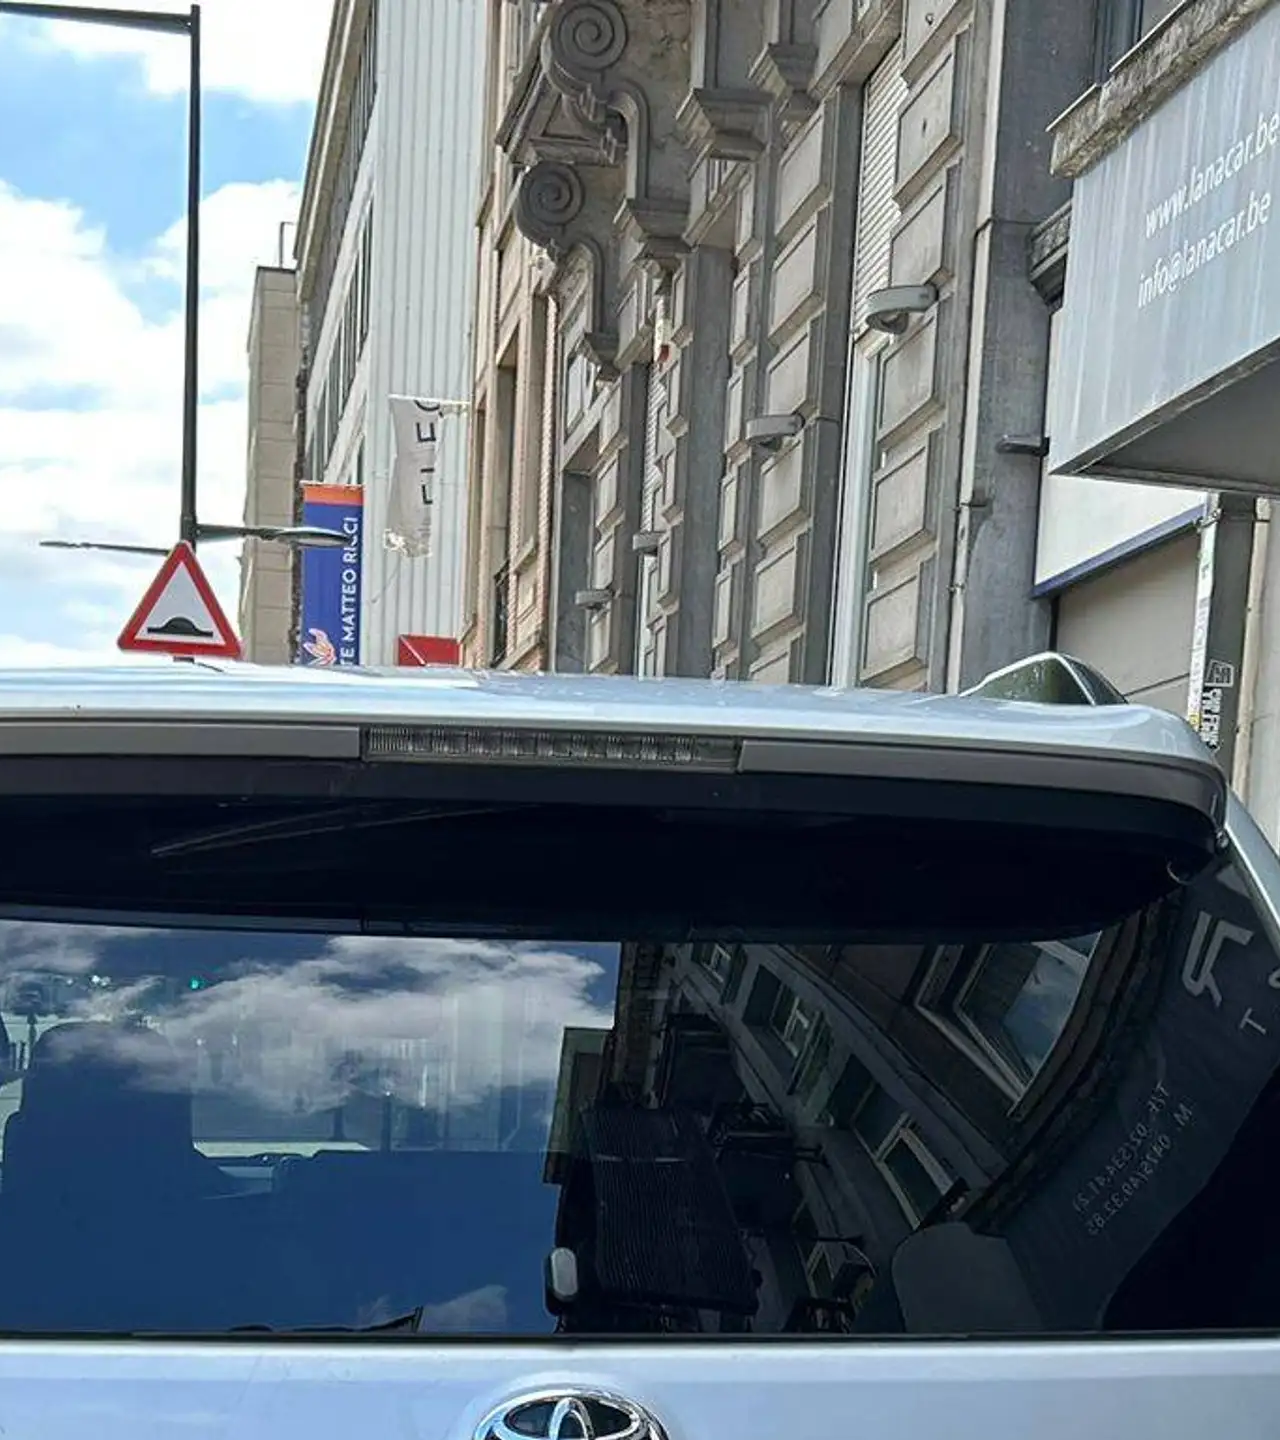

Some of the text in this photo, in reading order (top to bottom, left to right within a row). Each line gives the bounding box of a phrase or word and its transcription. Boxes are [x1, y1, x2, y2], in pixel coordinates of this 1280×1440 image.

[1145, 111, 1280, 239] www.lanacar.be
[1137, 189, 1271, 309] info@lanacar.be
[340, 568, 357, 644] MATTEO
